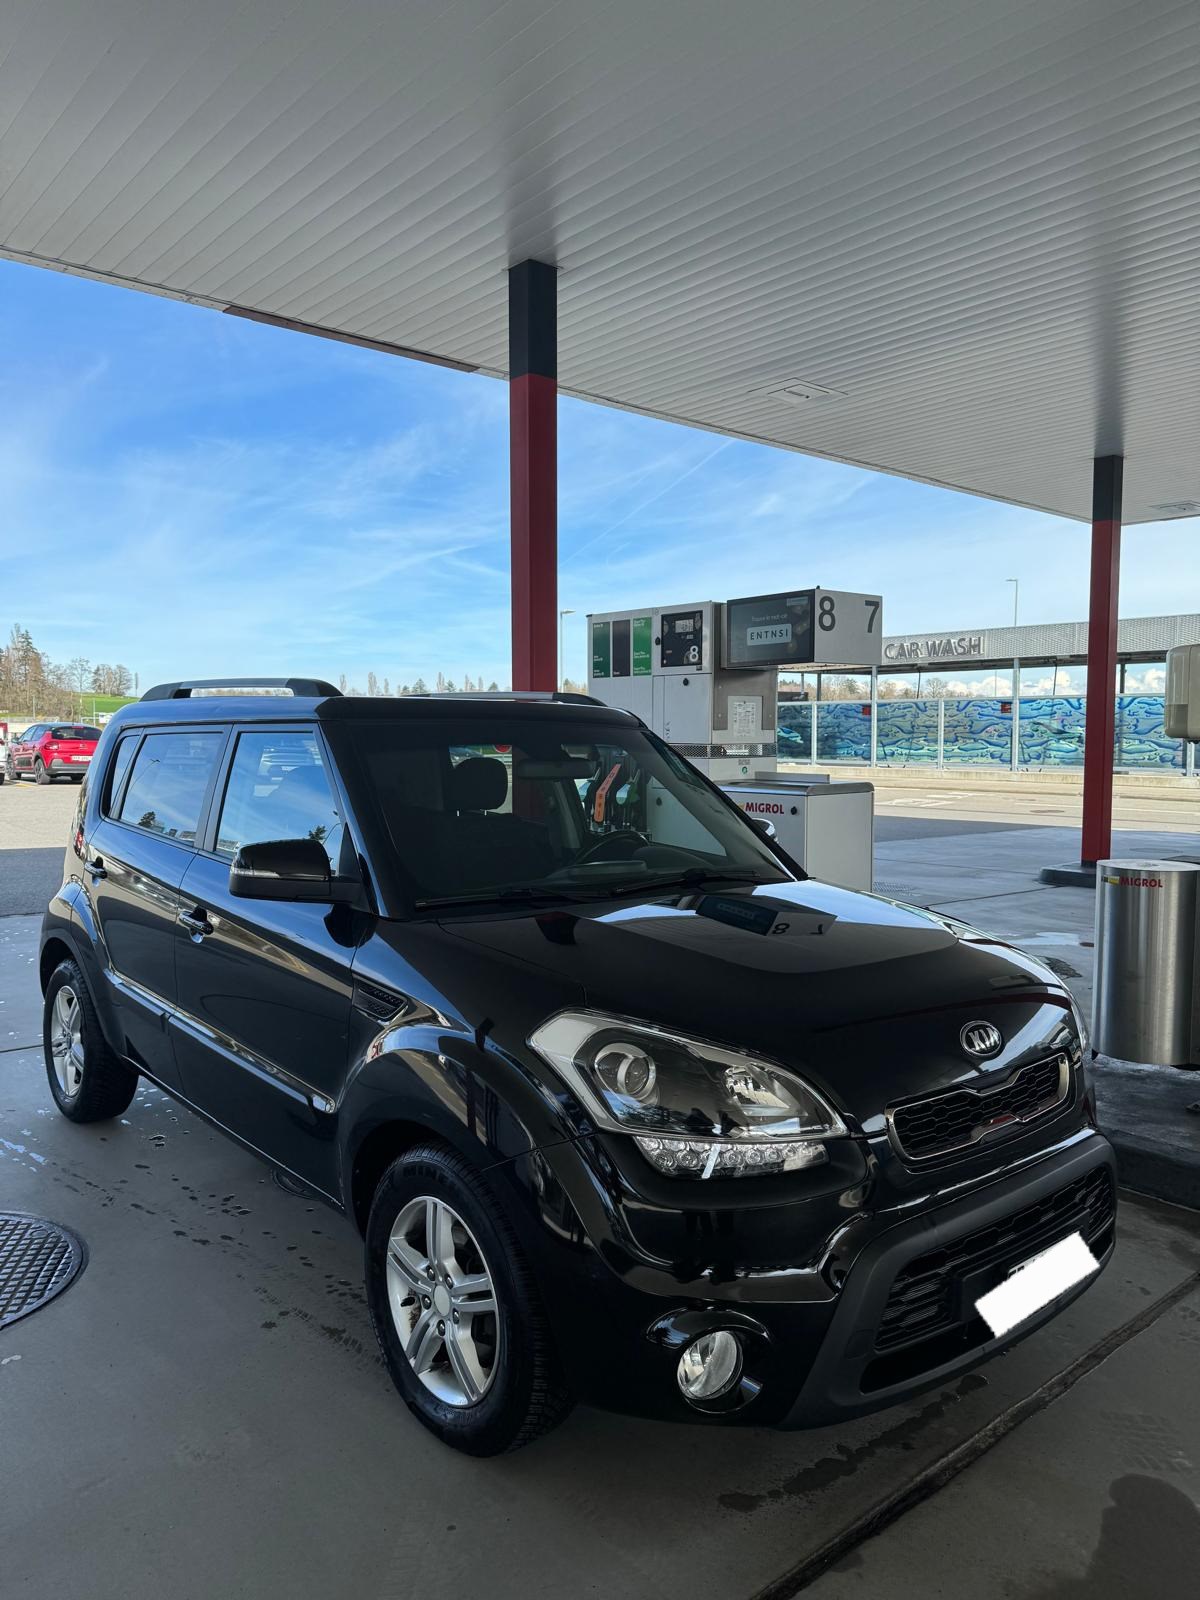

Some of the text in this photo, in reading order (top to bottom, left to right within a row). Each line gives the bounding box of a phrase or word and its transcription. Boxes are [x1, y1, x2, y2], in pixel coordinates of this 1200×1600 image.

[818, 595, 880, 634] 8 7
[750, 628, 788, 641] ENTNSI
[690, 645, 699, 662] 8
[884, 636, 984, 660] CAR WASH
[745, 802, 785, 814] MIGROL
[1119, 876, 1163, 888] MIGROL
[967, 1027, 1000, 1051] KIA
